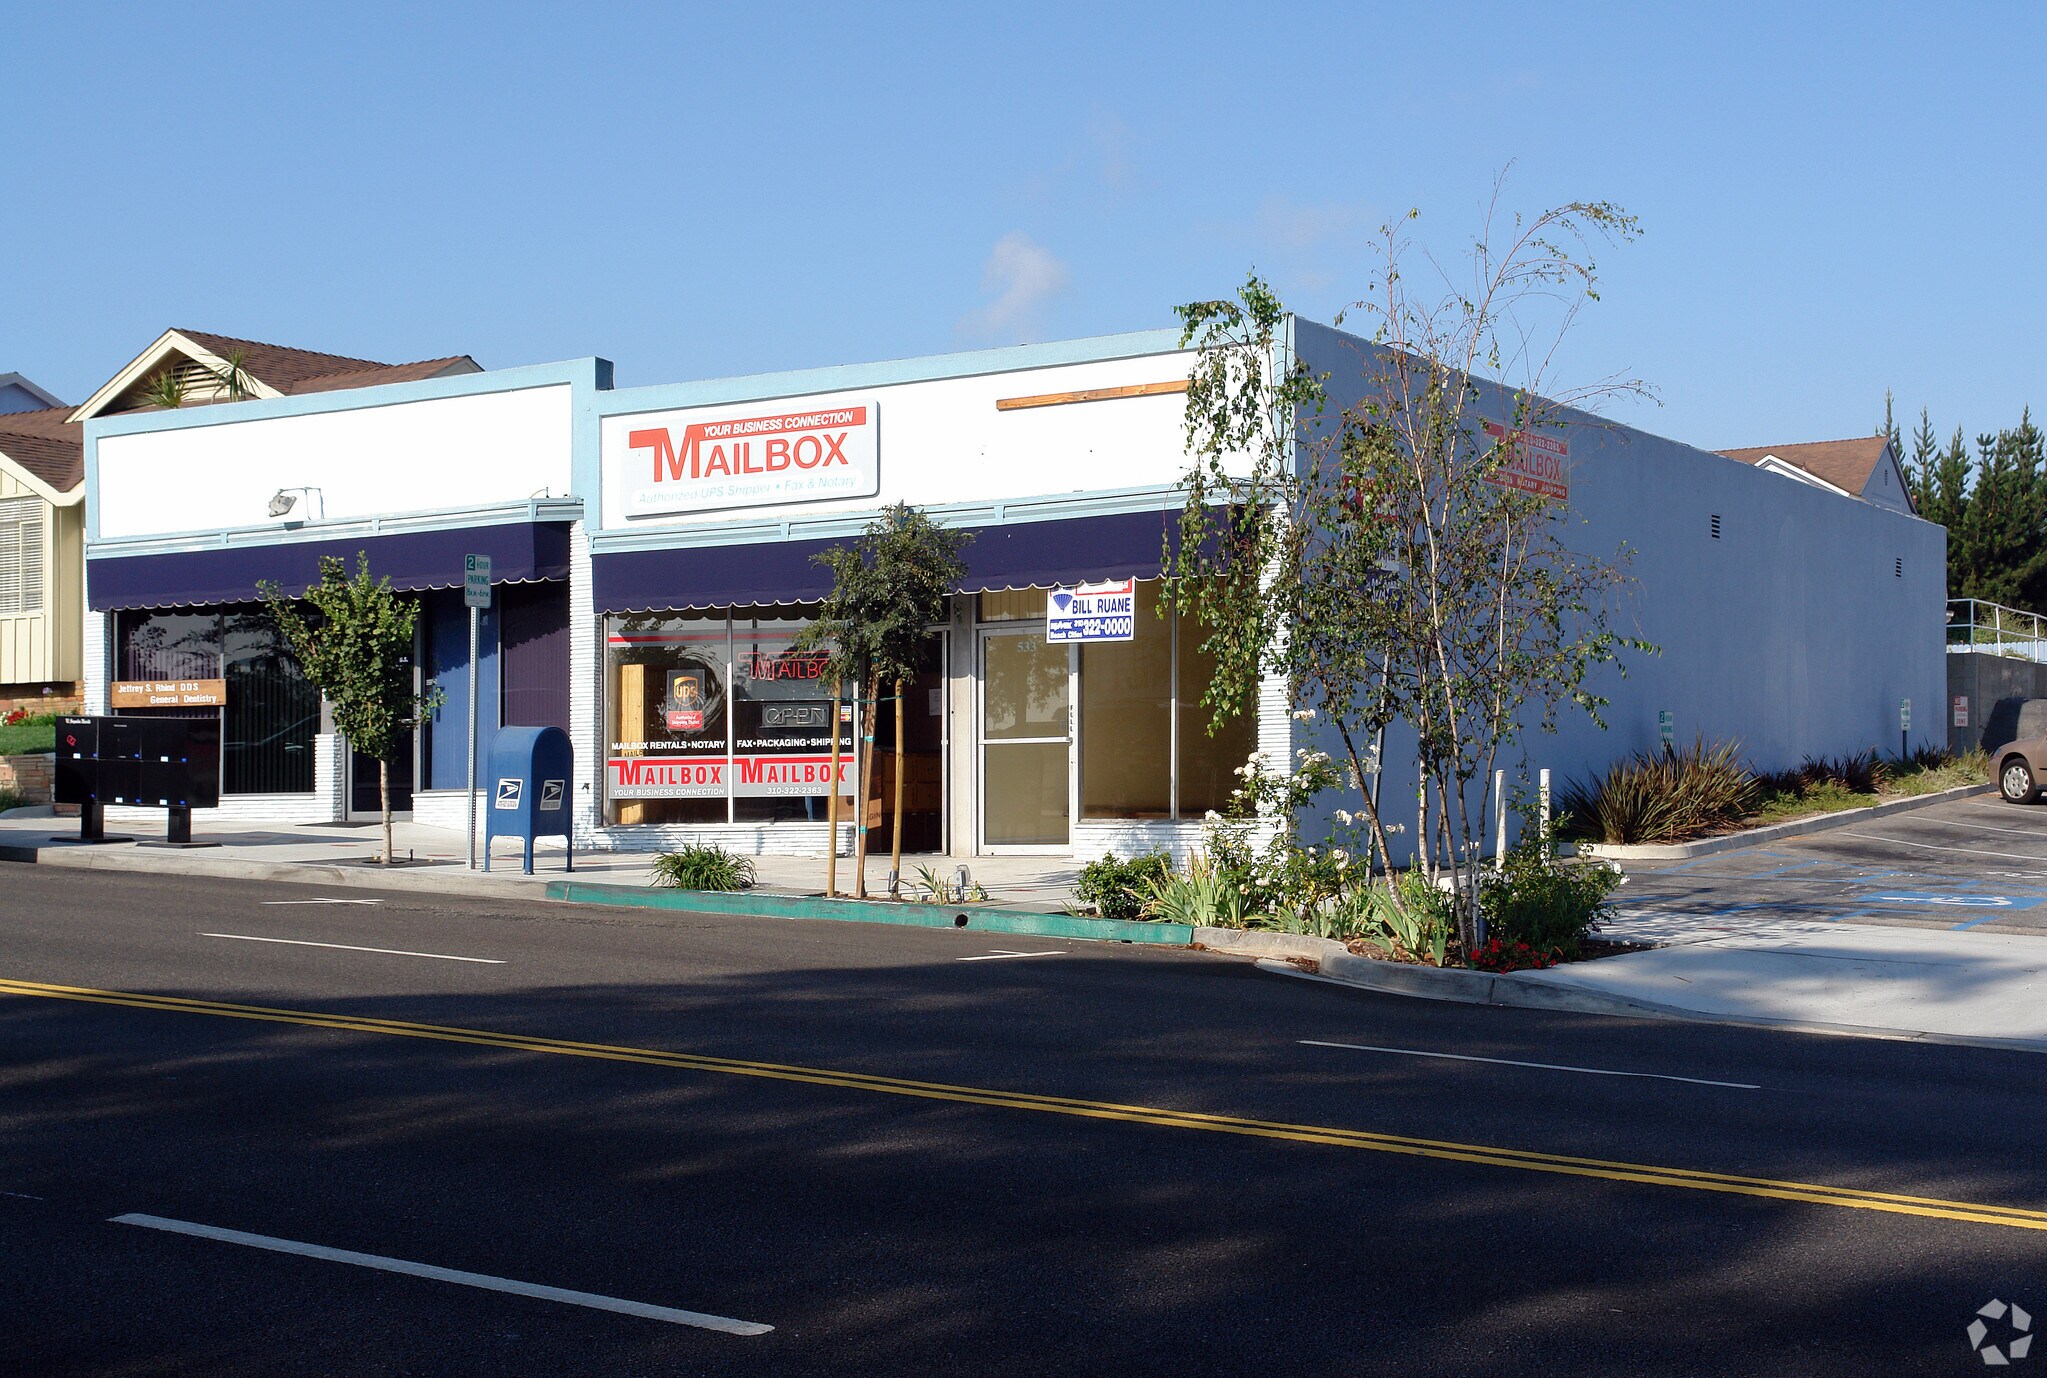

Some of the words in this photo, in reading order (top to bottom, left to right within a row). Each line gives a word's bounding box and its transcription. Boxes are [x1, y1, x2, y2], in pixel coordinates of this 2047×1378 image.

[704, 424, 731, 437] YOUR
[733, 418, 783, 434] BUSINESS
[784, 410, 854, 429] CONNECTION
[629, 424, 849, 483] MAILBOX
[700, 485, 724, 499] UPS
[727, 482, 771, 498] Shipper
[784, 479, 804, 491] Fax
[819, 476, 857, 490] Notary
[468, 557, 475, 569] 2
[476, 561, 489, 569] HOUR
[467, 575, 489, 585] PARKING
[1072, 600, 1092, 614] BILL
[1097, 597, 1131, 613] RUANE
[1083, 617, 1131, 636] 322-0000
[1017, 641, 1038, 653] 533
[738, 651, 832, 681] MAILBO
[118, 685, 144, 693] Jeffrey
[145, 683, 152, 692] S.
[155, 683, 176, 692] Rhind
[676, 684, 698, 702] ups
[150, 695, 178, 704] General
[183, 695, 217, 704] Dentistry
[765, 707, 825, 725] OPEN
[611, 741, 648, 750] MAILBOX
[650, 741, 687, 749] RENTALS
[691, 740, 725, 749] NOTARY
[736, 739, 753, 748] FAX
[757, 738, 806, 748] PACKAGING
[811, 737, 852, 746] SHIPPNG
[619, 760, 722, 785] MAILBOX
[740, 758, 846, 784] MAILBOX
[614, 788, 634, 796] YOUR
[636, 788, 674, 796] BUSINESS
[676, 787, 725, 796] CONNECTION
[767, 786, 822, 795] 310-322-2363
